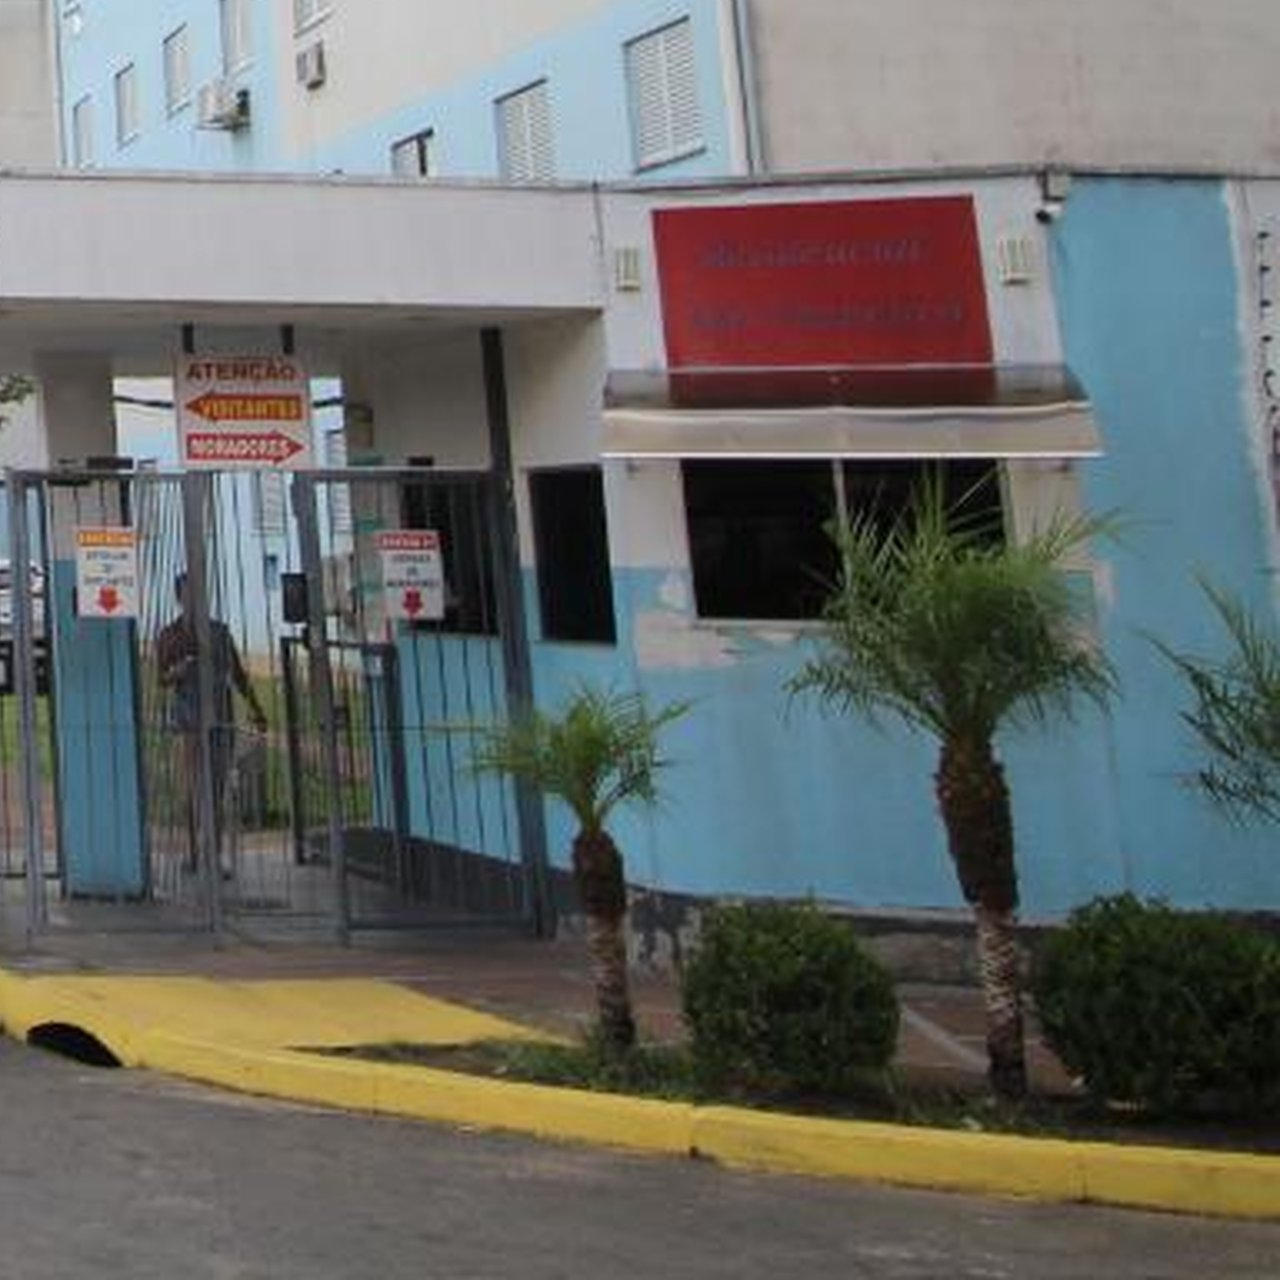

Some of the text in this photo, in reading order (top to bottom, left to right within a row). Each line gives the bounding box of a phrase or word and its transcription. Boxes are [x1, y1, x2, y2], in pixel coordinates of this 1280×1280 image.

[186, 357, 295, 382] ATENÇÃO
[200, 398, 298, 417] VISITANTES
[190, 438, 290, 456] MORADORES
